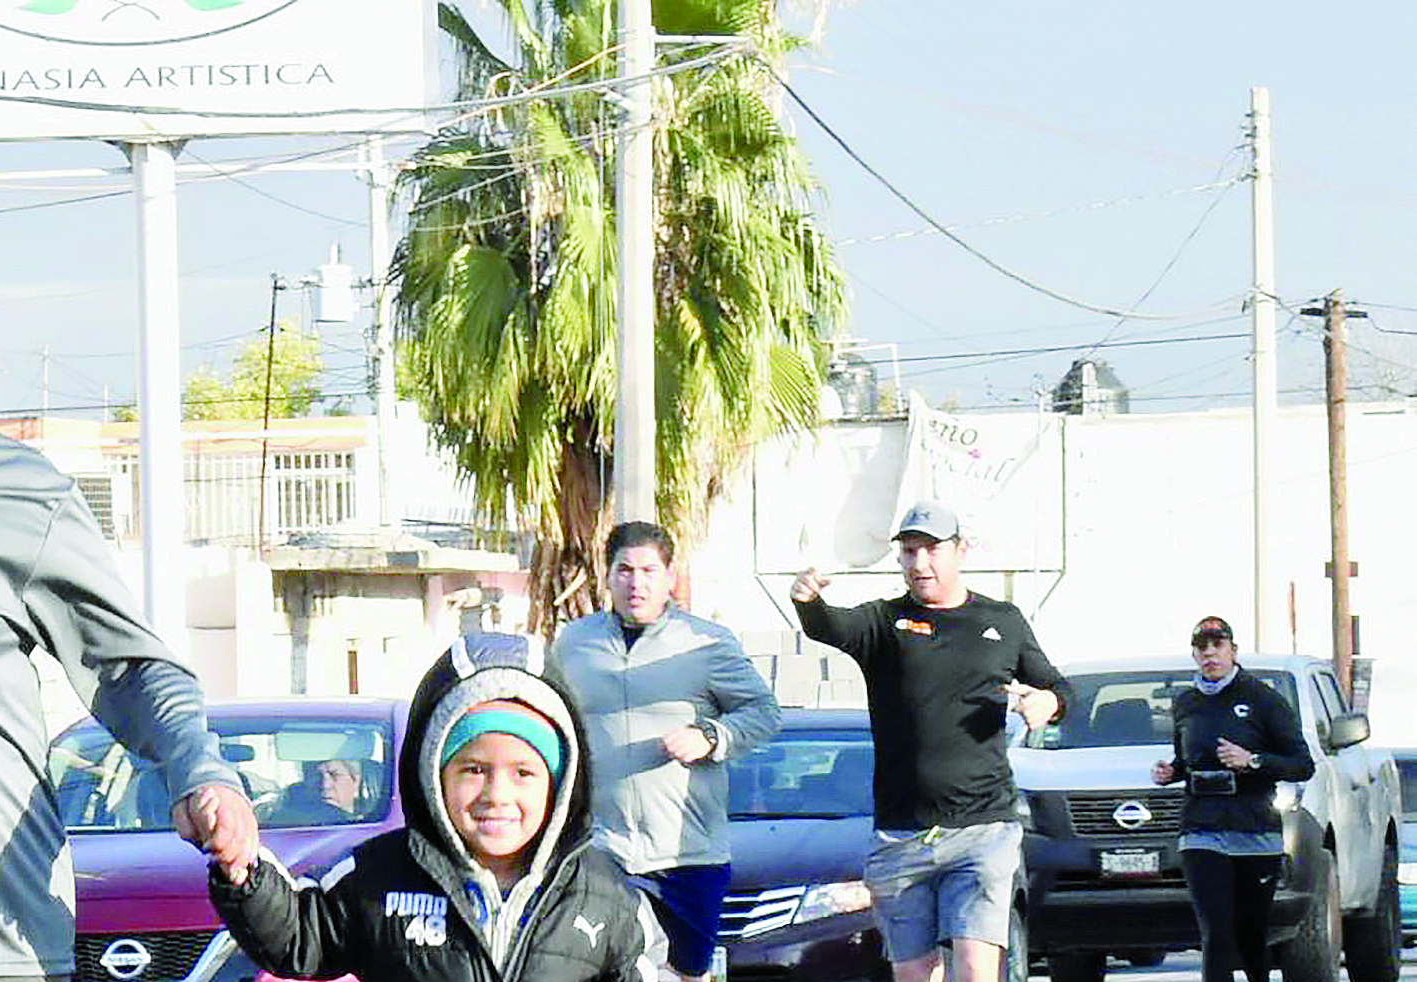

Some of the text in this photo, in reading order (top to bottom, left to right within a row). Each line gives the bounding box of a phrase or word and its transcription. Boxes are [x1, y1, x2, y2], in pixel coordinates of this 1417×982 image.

[123, 63, 335, 88] ARTISTICA
[386, 892, 448, 917] PUMA
[405, 915, 447, 946] 48
